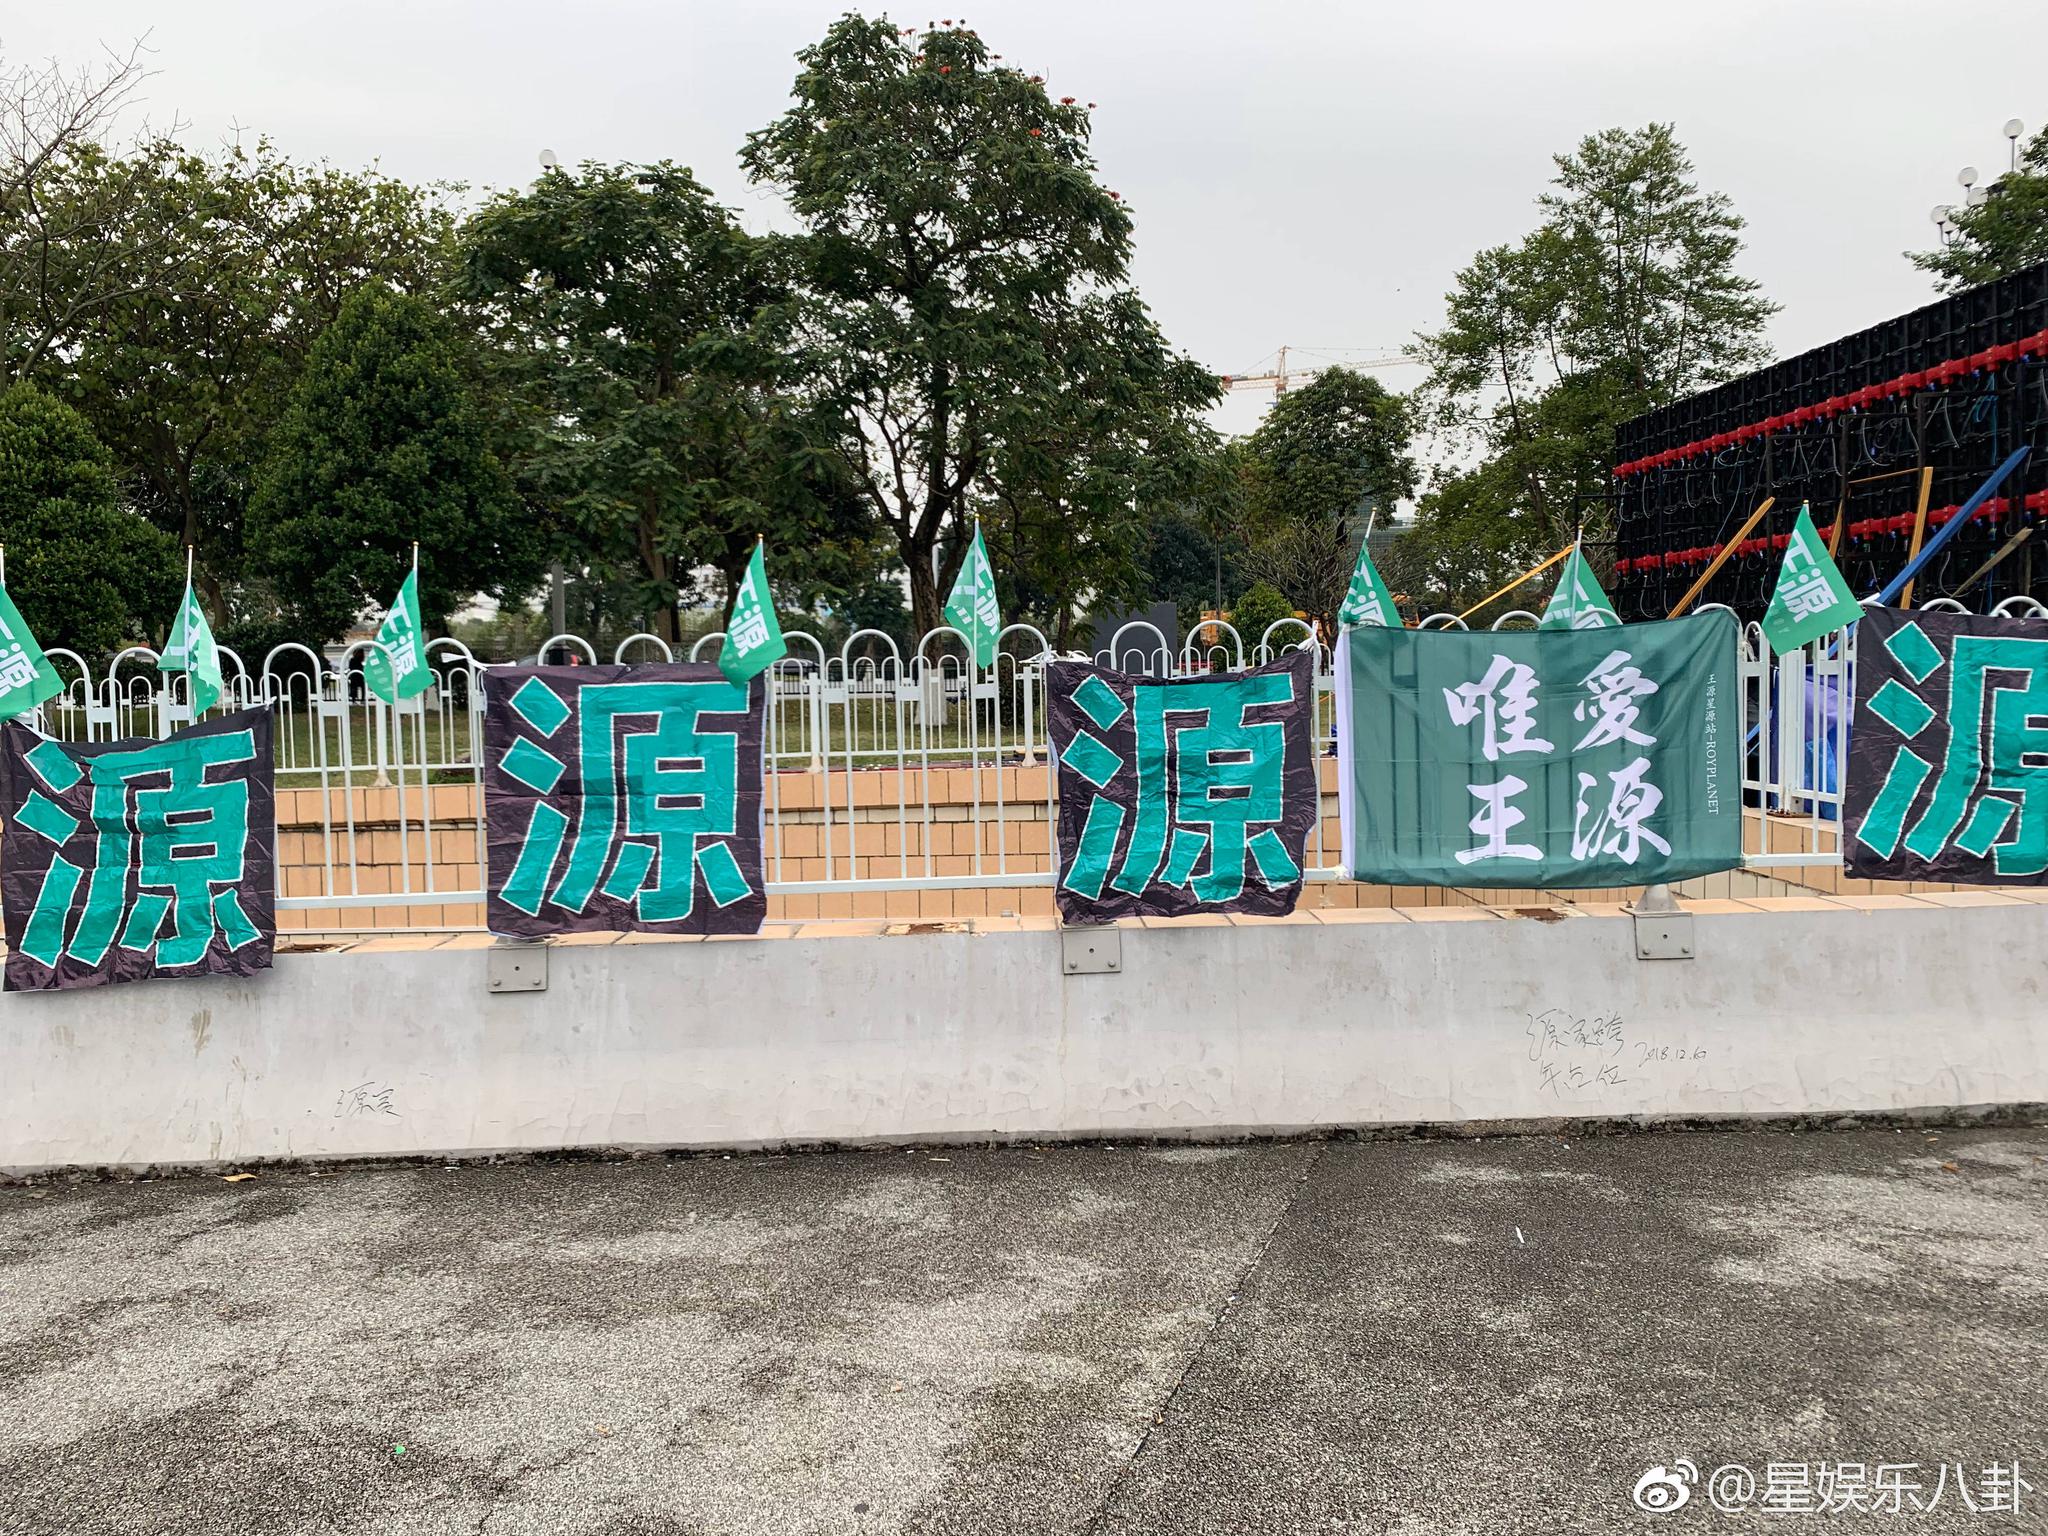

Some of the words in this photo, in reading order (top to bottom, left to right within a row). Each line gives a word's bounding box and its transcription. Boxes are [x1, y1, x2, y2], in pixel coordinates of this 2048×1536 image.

[13, 728, 262, 968] 源
[498, 676, 753, 922] 源
[1060, 672, 1300, 902] 源
[1455, 757, 1672, 865] 王源
[1856, 620, 2048, 876] 源
